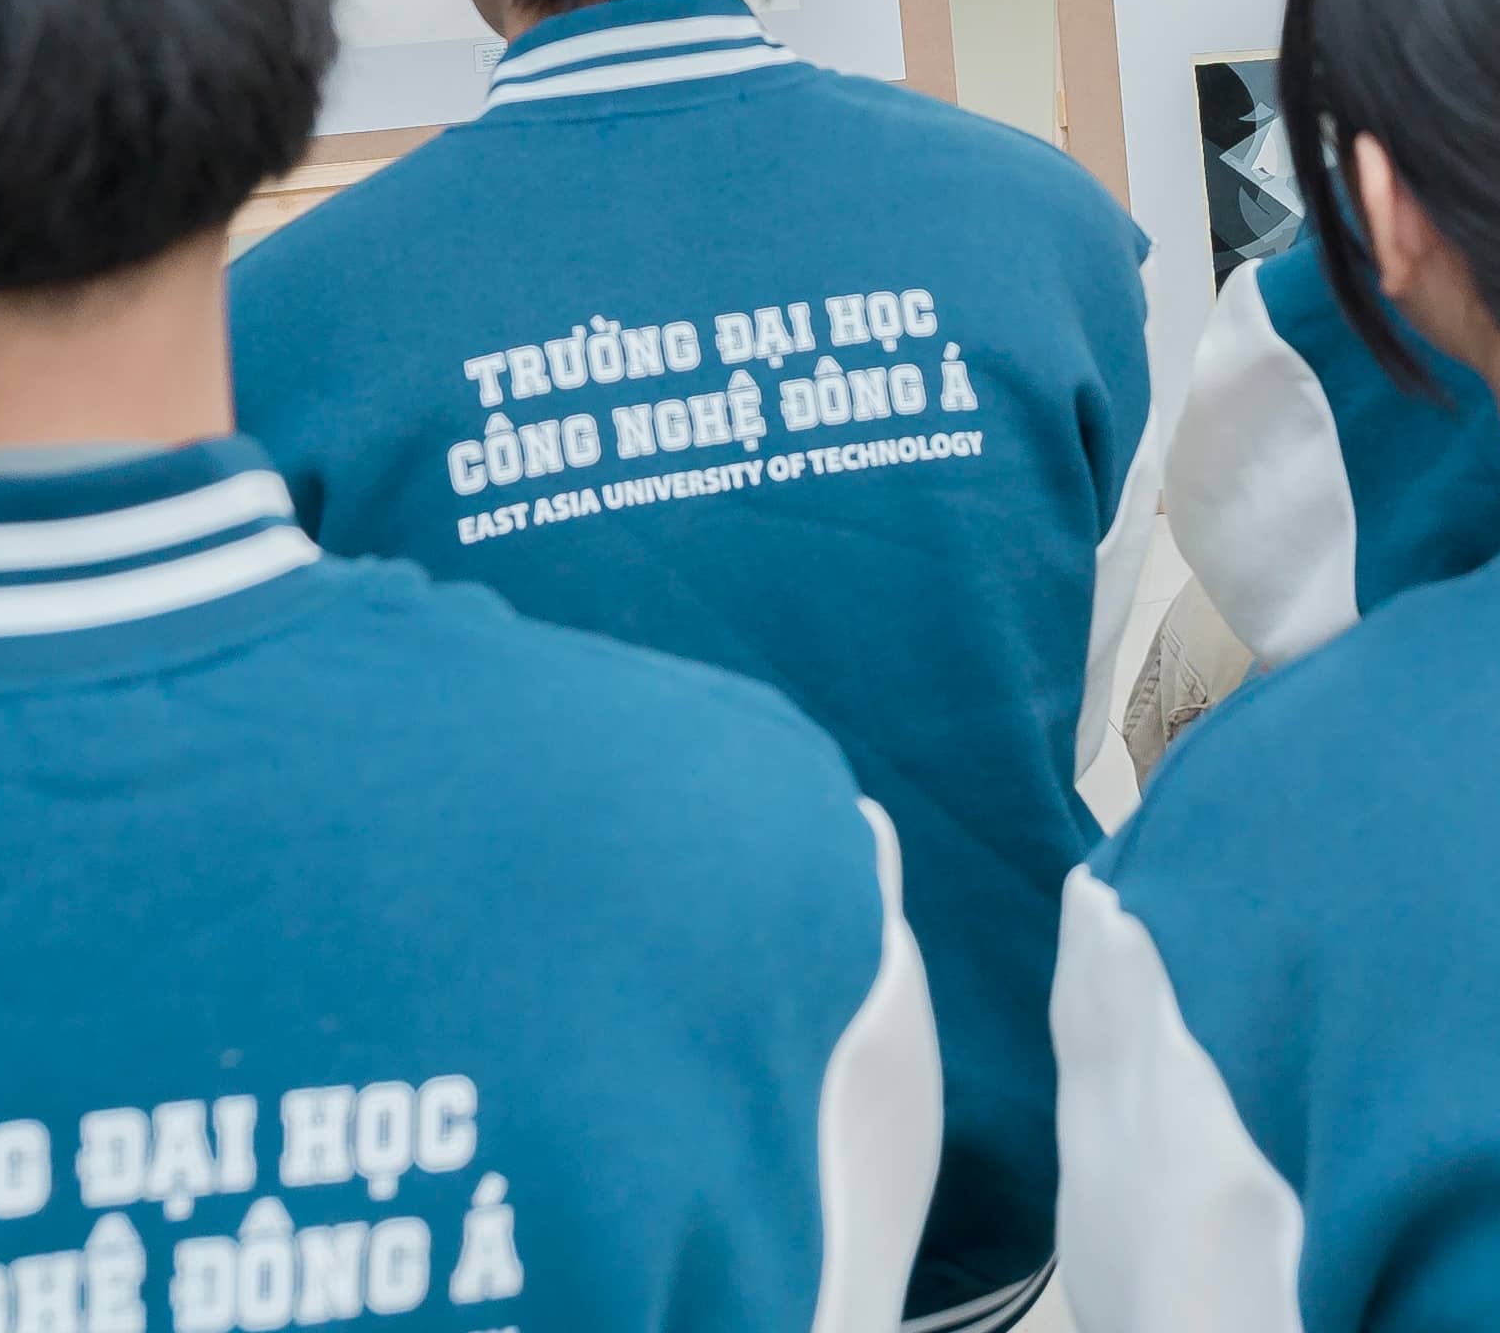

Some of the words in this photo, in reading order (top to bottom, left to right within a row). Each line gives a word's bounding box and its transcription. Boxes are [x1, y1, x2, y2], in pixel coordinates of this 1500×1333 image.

[447, 412, 602, 496] CÔNG
[612, 369, 767, 460] NGHỆ
[779, 355, 927, 432] ĐÔNG
[940, 341, 979, 412] Á
[463, 314, 701, 408] TRƯỜNG
[714, 301, 817, 369] ĐẠI
[825, 288, 938, 352] HỌC
[457, 501, 528, 546] EAST
[533, 489, 601, 526] ASIA
[601, 460, 763, 511] UNIVERSITY
[767, 450, 806, 483] OF
[806, 430, 984, 474] TECHNOLOGY
[76, 1094, 258, 1222] ĐẠI
[279, 1073, 478, 1202] HỌC
[172, 1196, 432, 1333] ĐÔNG
[450, 1171, 525, 1305] Á
